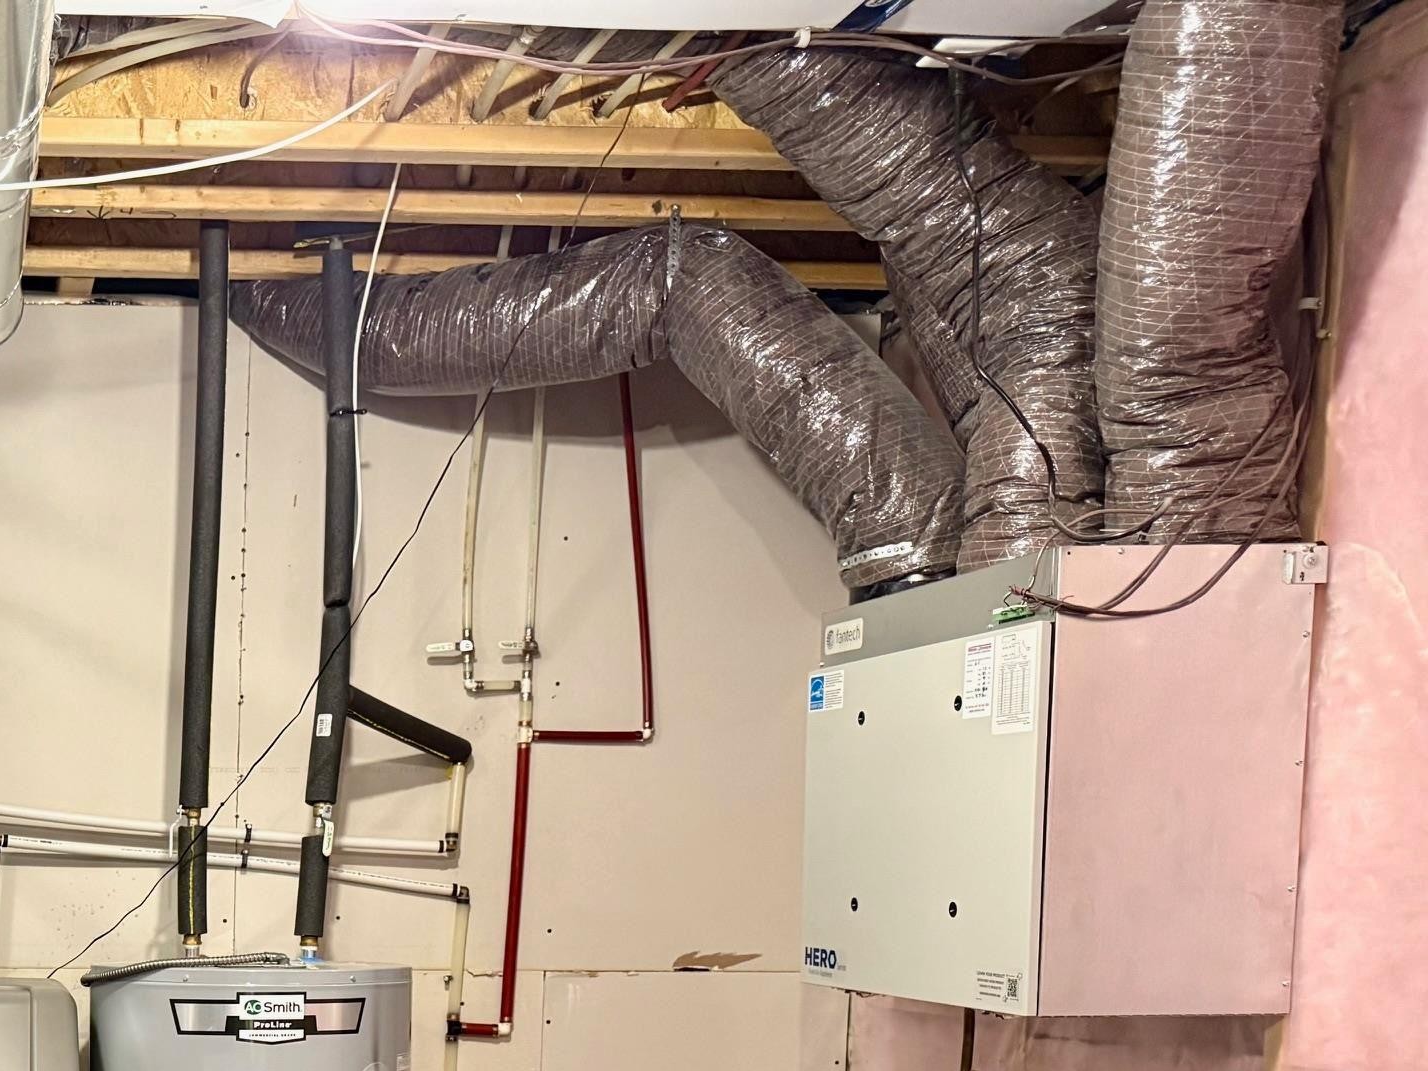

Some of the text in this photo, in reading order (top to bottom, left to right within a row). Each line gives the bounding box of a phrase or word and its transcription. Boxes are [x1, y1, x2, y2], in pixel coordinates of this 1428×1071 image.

[804, 946, 837, 970] HERO
[264, 1001, 301, 1013] Smith
[253, 1020, 292, 1029] ProLine
